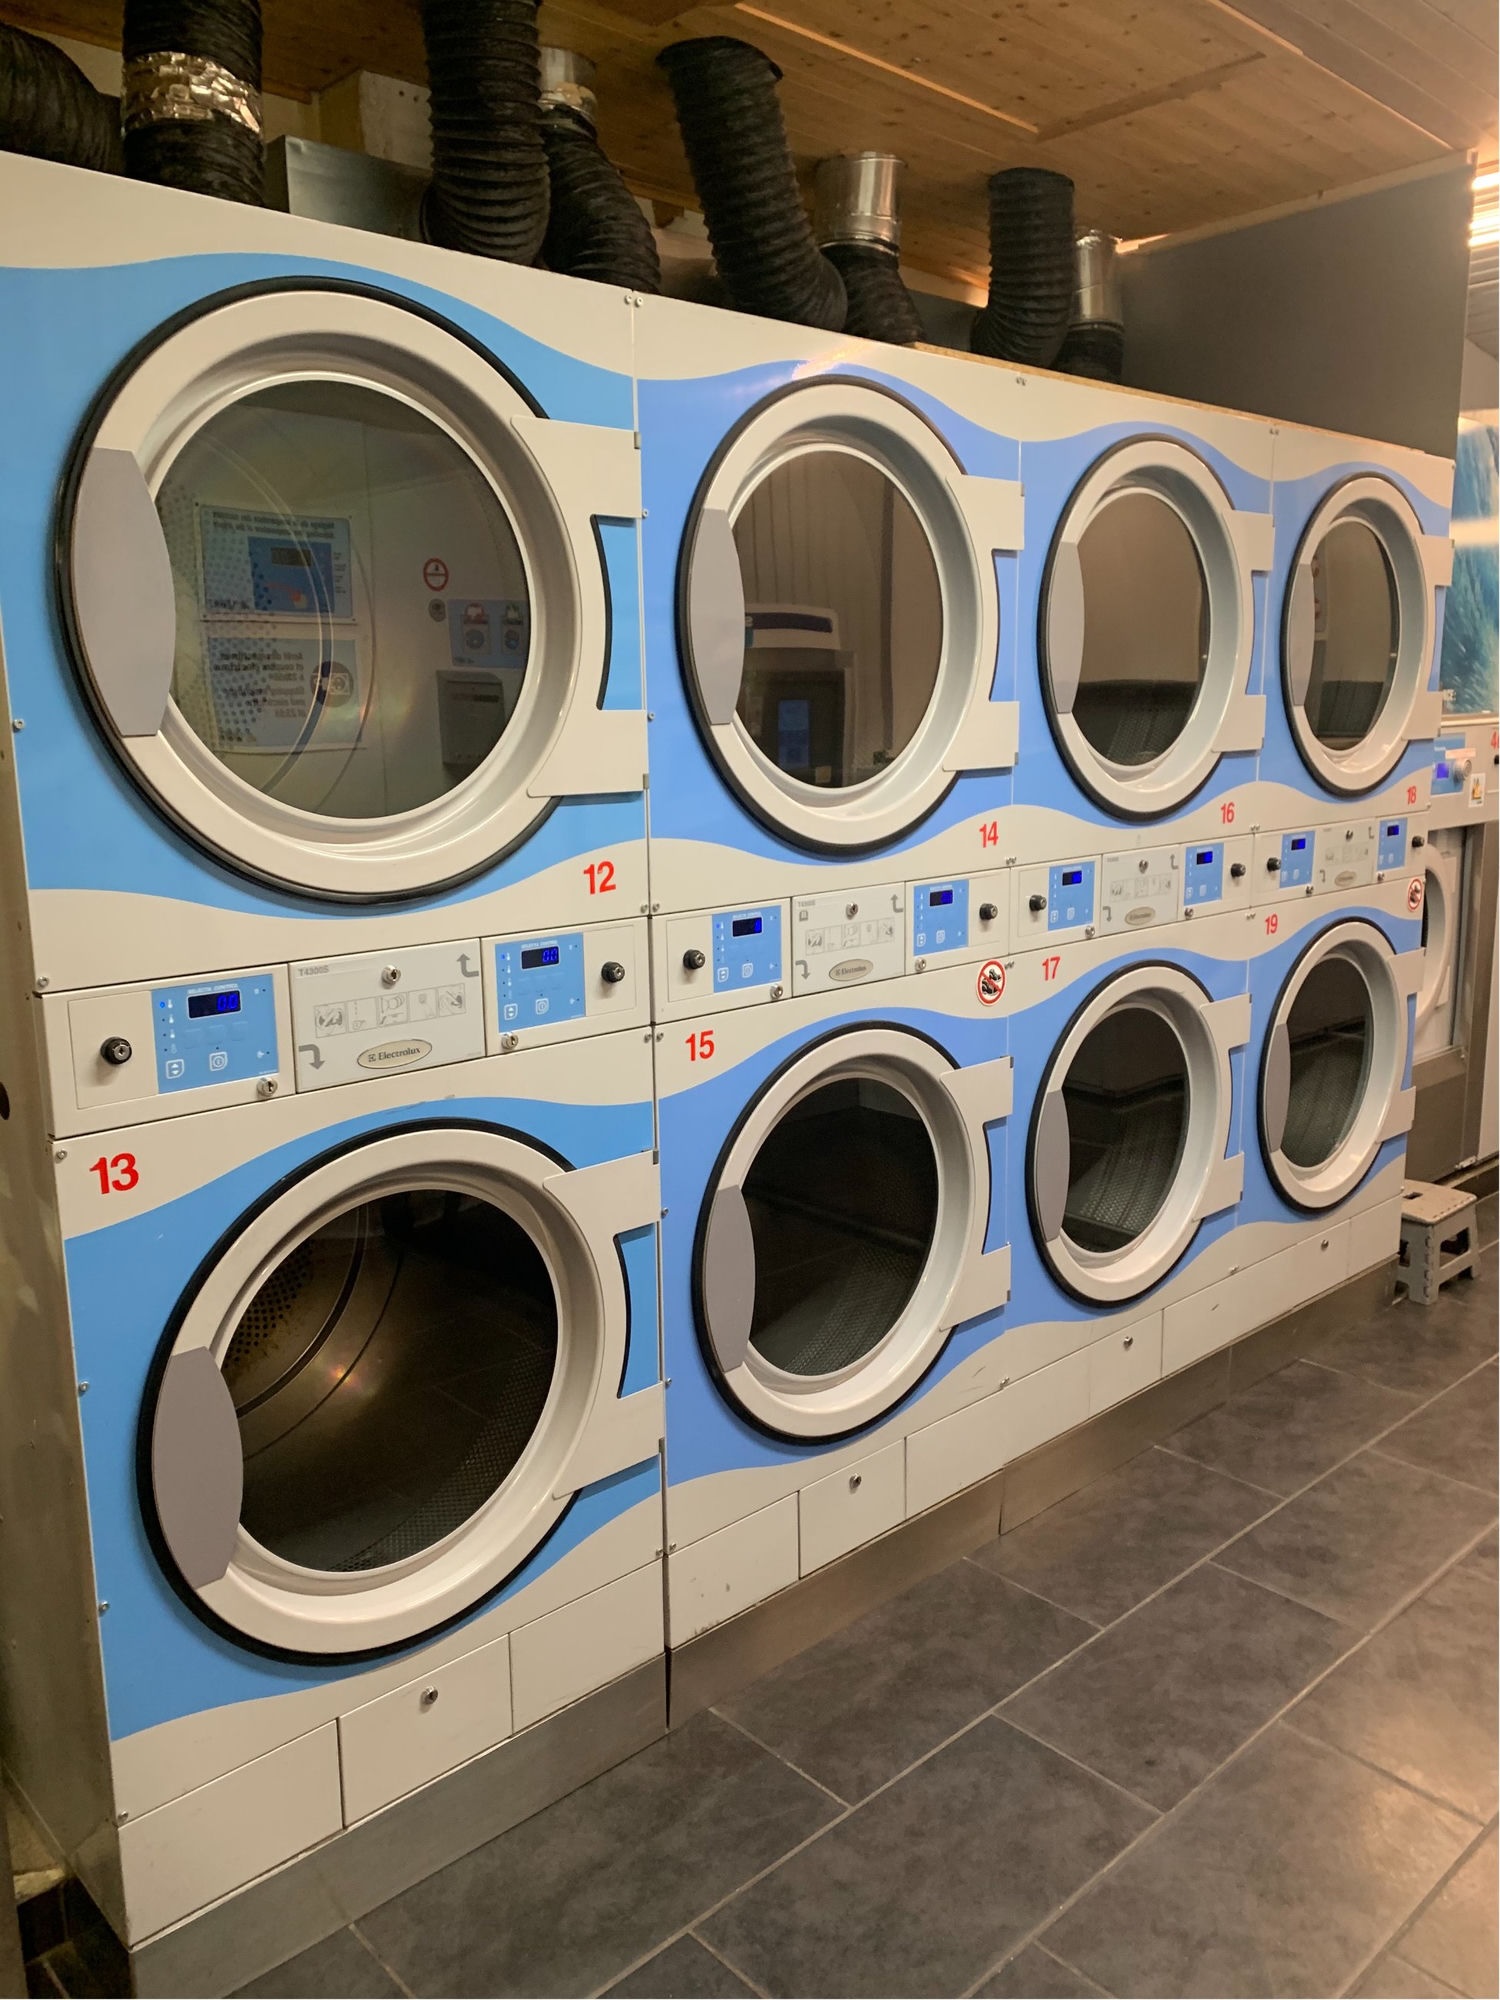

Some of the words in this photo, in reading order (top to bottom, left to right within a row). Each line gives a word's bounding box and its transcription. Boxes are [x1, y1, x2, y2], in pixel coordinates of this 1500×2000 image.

[1490, 731, 1499, 750] 4
[1407, 786, 1418, 807] 18
[1221, 802, 1236, 825] 16
[979, 821, 999, 849] 14
[583, 860, 617, 896] 12
[1265, 913, 1280, 936] 19
[1042, 956, 1062, 981] 17
[378, 1046, 421, 1063] Electrolux
[685, 1030, 716, 1063] 15
[89, 1151, 141, 1195] 13
